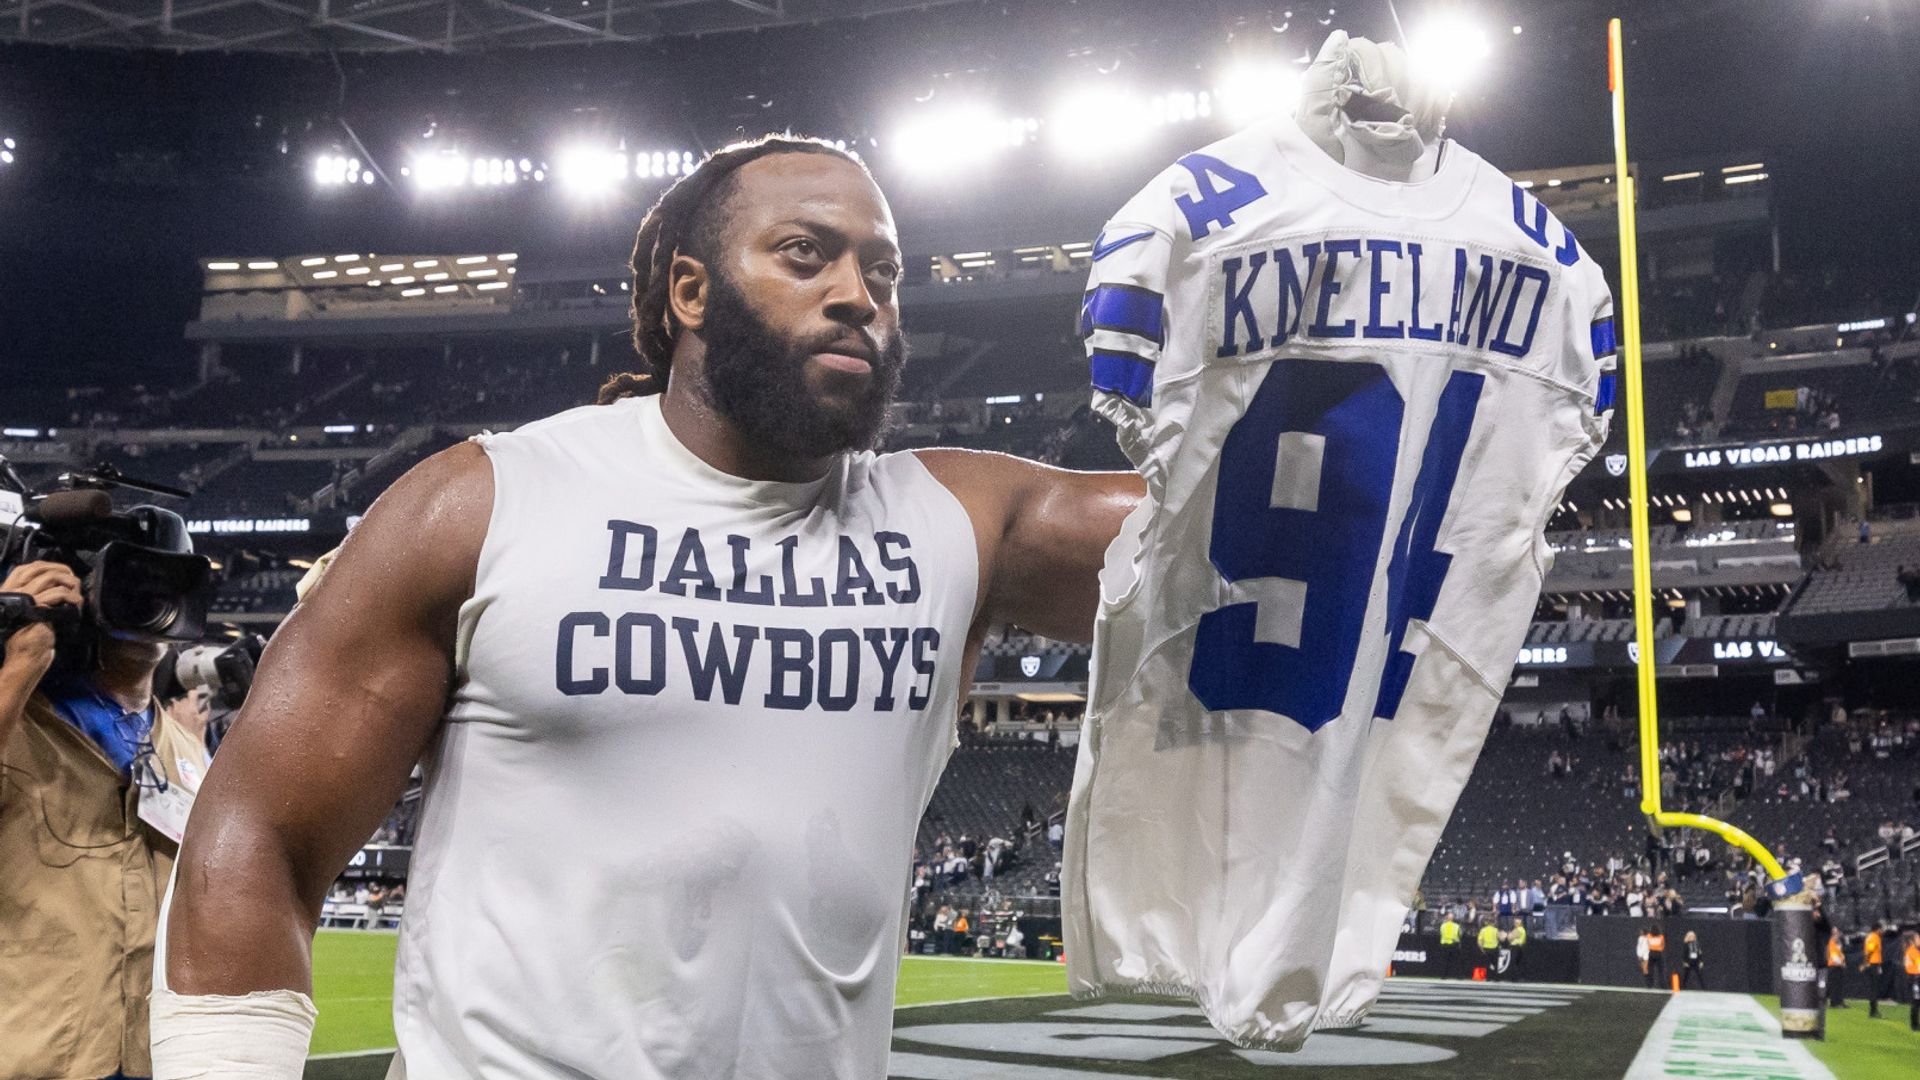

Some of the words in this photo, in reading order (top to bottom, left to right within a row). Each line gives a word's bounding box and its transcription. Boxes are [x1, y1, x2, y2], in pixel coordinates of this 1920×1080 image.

[1174, 153, 1268, 242] 4
[1217, 238, 1551, 358] KNEELAND
[1685, 451, 1721, 468] LAS
[1726, 444, 1792, 464] VEGAS
[1796, 435, 1883, 460] RAIDERS
[187, 520, 211, 533] LAS
[213, 519, 254, 532] VEGAS
[255, 518, 310, 532] RAIDERS
[599, 519, 921, 607] DALLAS
[556, 611, 941, 712] COWBOYS
[1515, 647, 1567, 664] DERS
[1713, 641, 1753, 659] LAS
